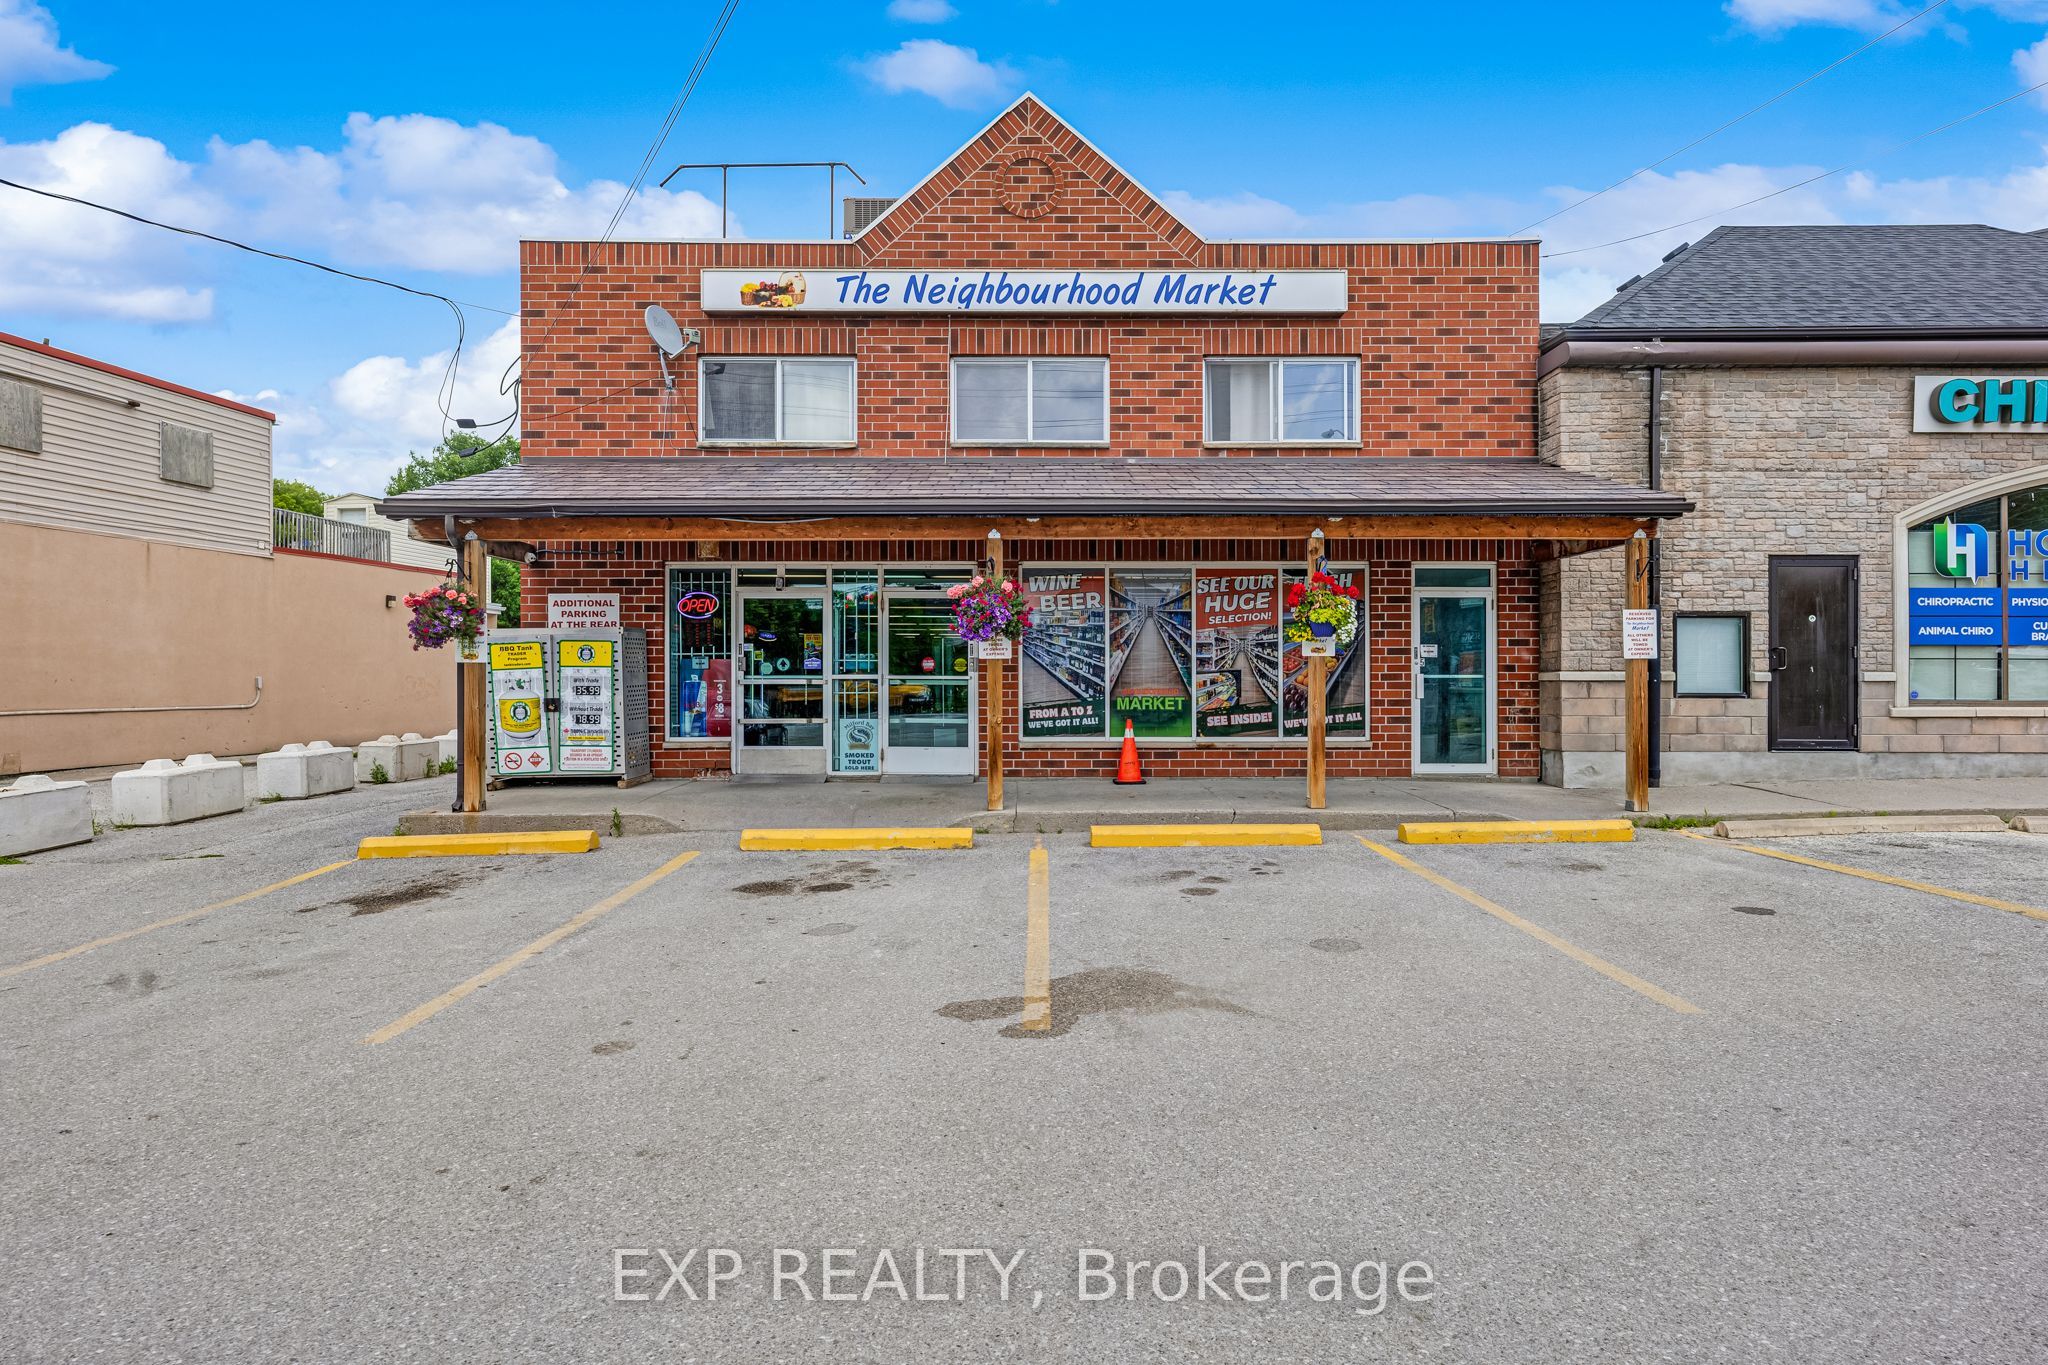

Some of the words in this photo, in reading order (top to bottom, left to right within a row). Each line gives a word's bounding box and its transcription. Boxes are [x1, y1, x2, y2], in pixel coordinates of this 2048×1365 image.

[836, 272, 890, 304] The
[903, 272, 1144, 309] Neighbourhood
[1154, 274, 1277, 305] Market
[2011, 559, 2048, 581] H
[1028, 574, 1082, 592] WINE
[1197, 577, 1230, 594] SEE
[1234, 574, 1274, 591] OUR
[680, 598, 716, 612] OPEN
[1040, 592, 1102, 612] BEER
[1205, 592, 1270, 612] HUGE
[1917, 597, 1994, 606] CHIROPRACTIC
[1208, 612, 1272, 624] SELECTION!
[1918, 626, 1959, 635] ANIMAL
[1960, 626, 1994, 635] CHIRO
[717, 684, 722, 694] 3
[715, 703, 724, 713] $8
[1116, 697, 1185, 710] MARKET
[1029, 708, 1058, 719] FROM
[1061, 708, 1069, 716] A
[1071, 706, 1084, 716] TO
[1086, 706, 1093, 714] Z
[1207, 716, 1228, 726] SEE
[1230, 712, 1273, 725] INSIDE!
[1082, 717, 1098, 725] ALL!
[1284, 718, 1308, 728] WE'V
[1336, 714, 1344, 722] IT
[1346, 712, 1362, 721] ALL
